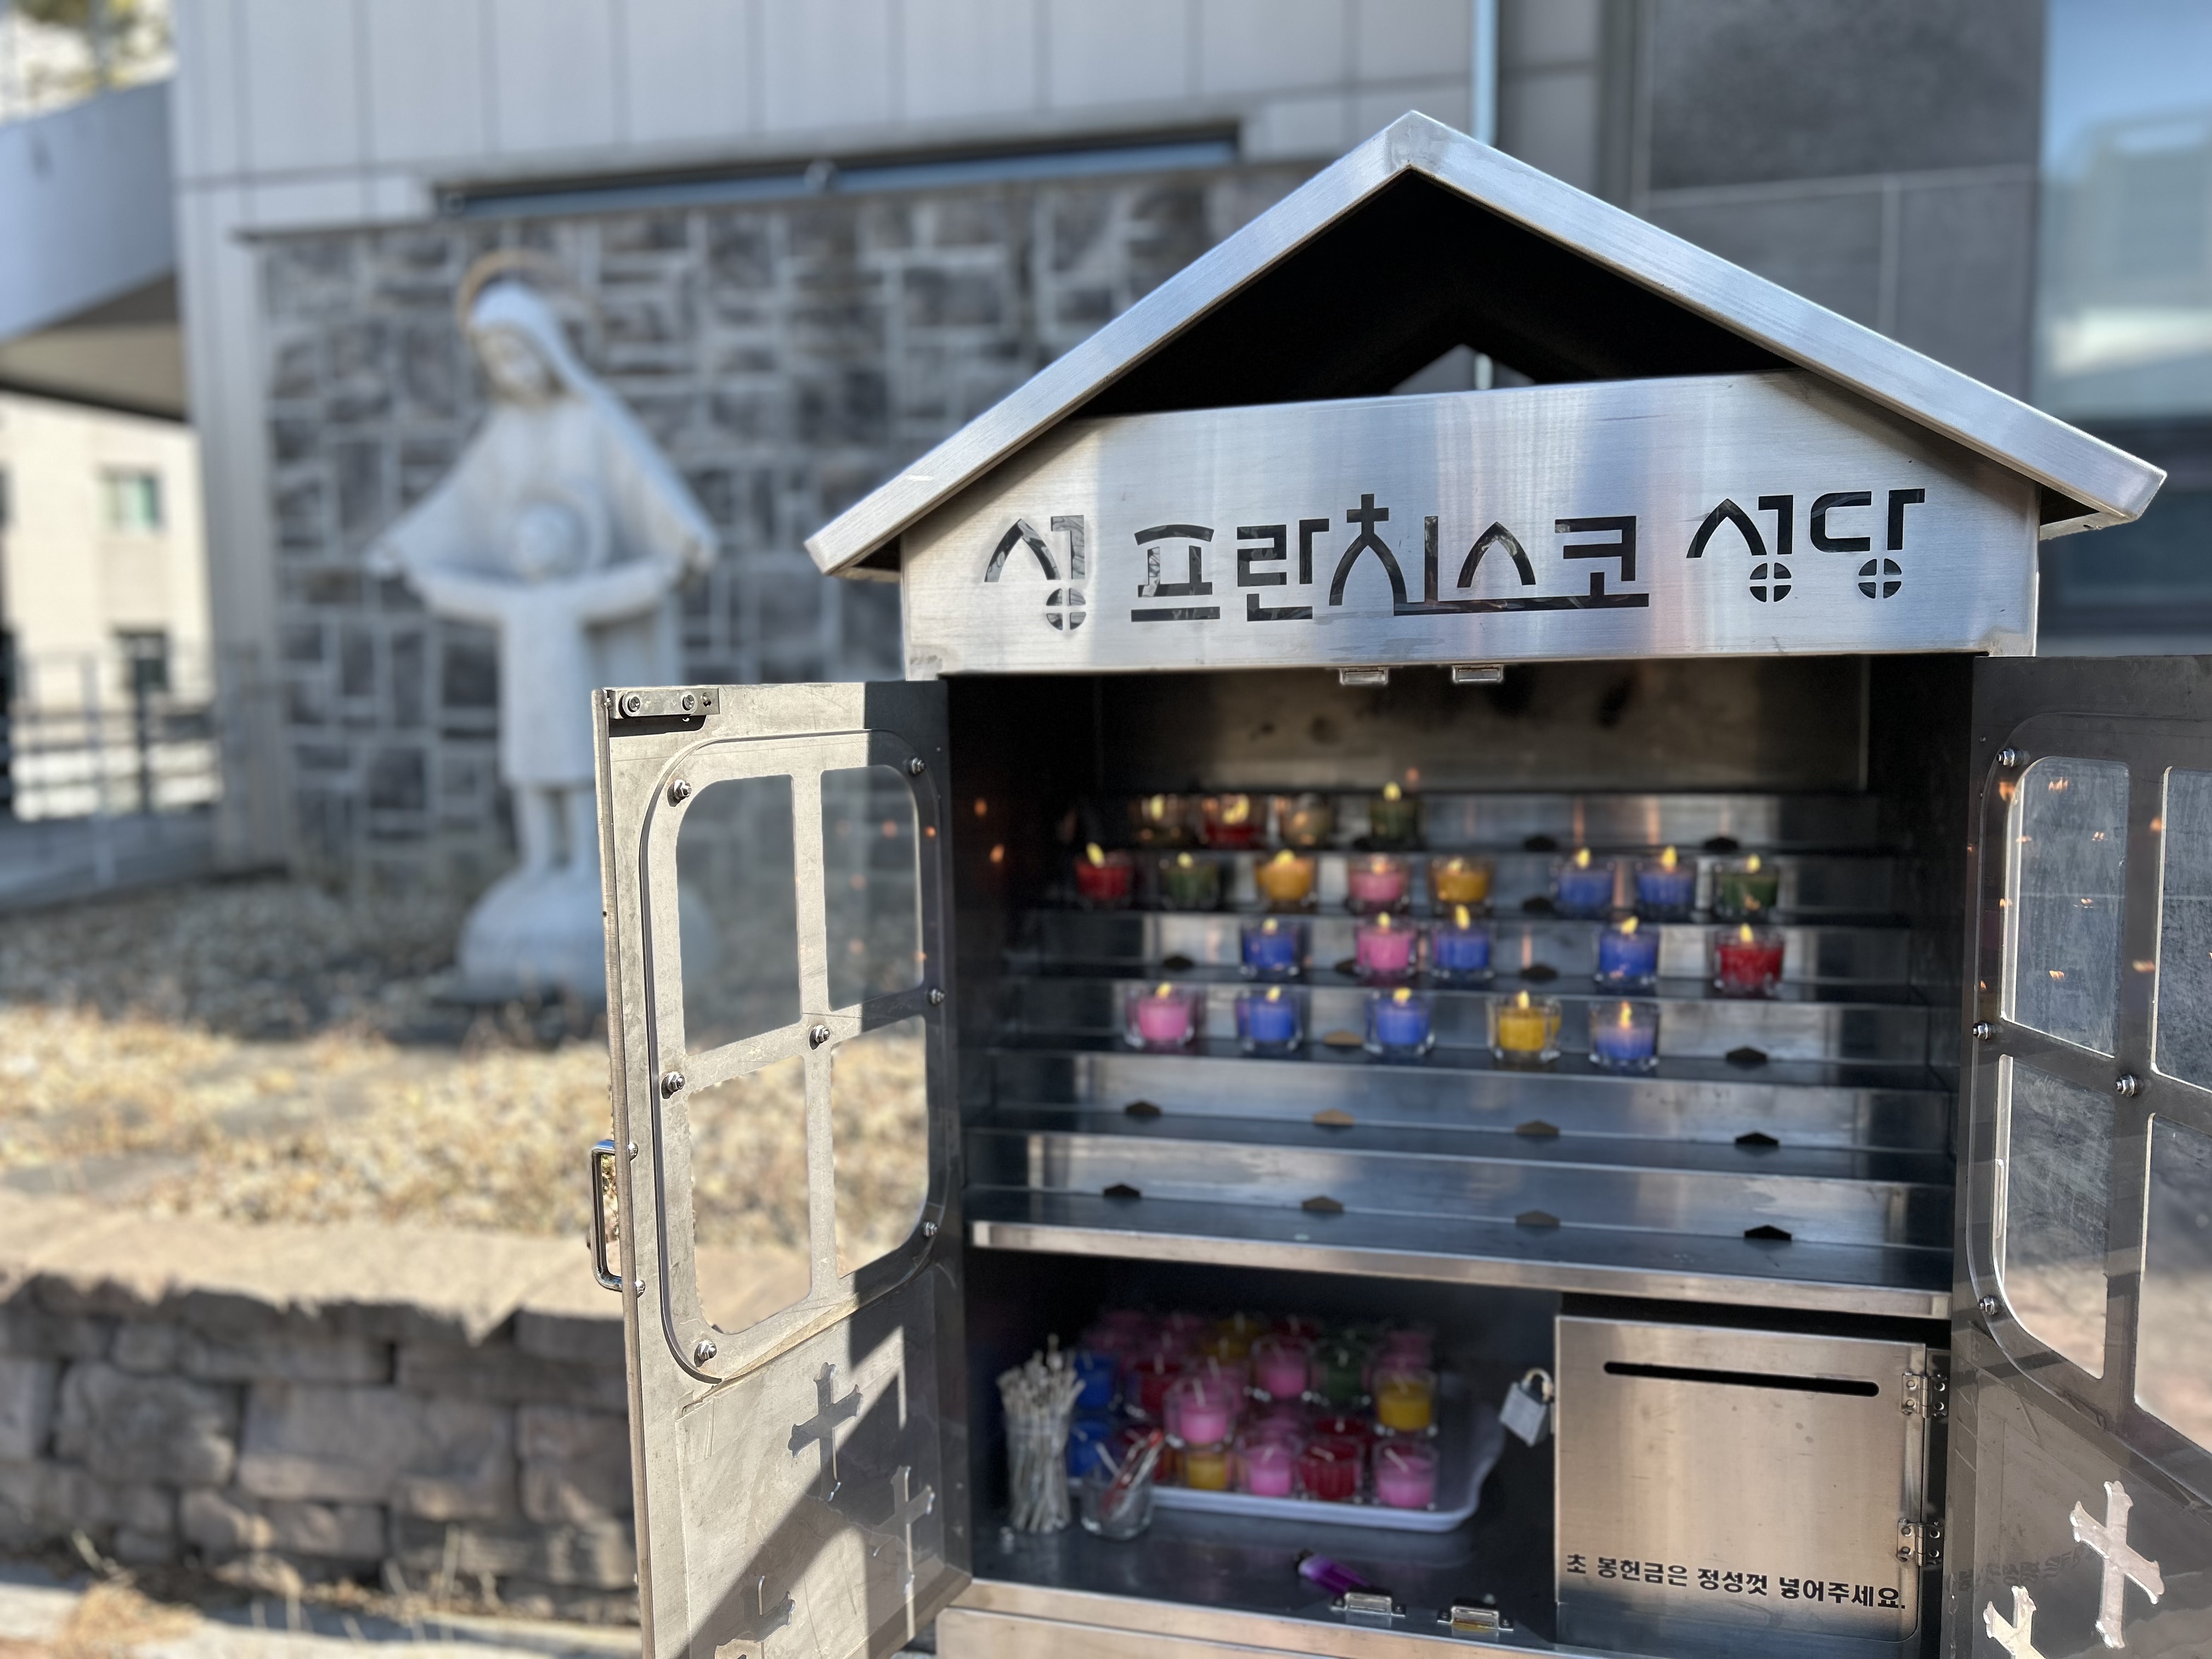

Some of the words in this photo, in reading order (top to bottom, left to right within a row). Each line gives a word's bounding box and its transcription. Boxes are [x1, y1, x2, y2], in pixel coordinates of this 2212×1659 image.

[984, 514, 1087, 632] 성
[1130, 493, 1650, 622] 프란치스코
[1685, 488, 1926, 603] 성당
[1566, 1554, 1587, 1575] 초
[1597, 1556, 1688, 1587] 봉헌금은
[1697, 1567, 1768, 1596] 정성껏
[1779, 1576, 1905, 1610] 넣어주세요.
